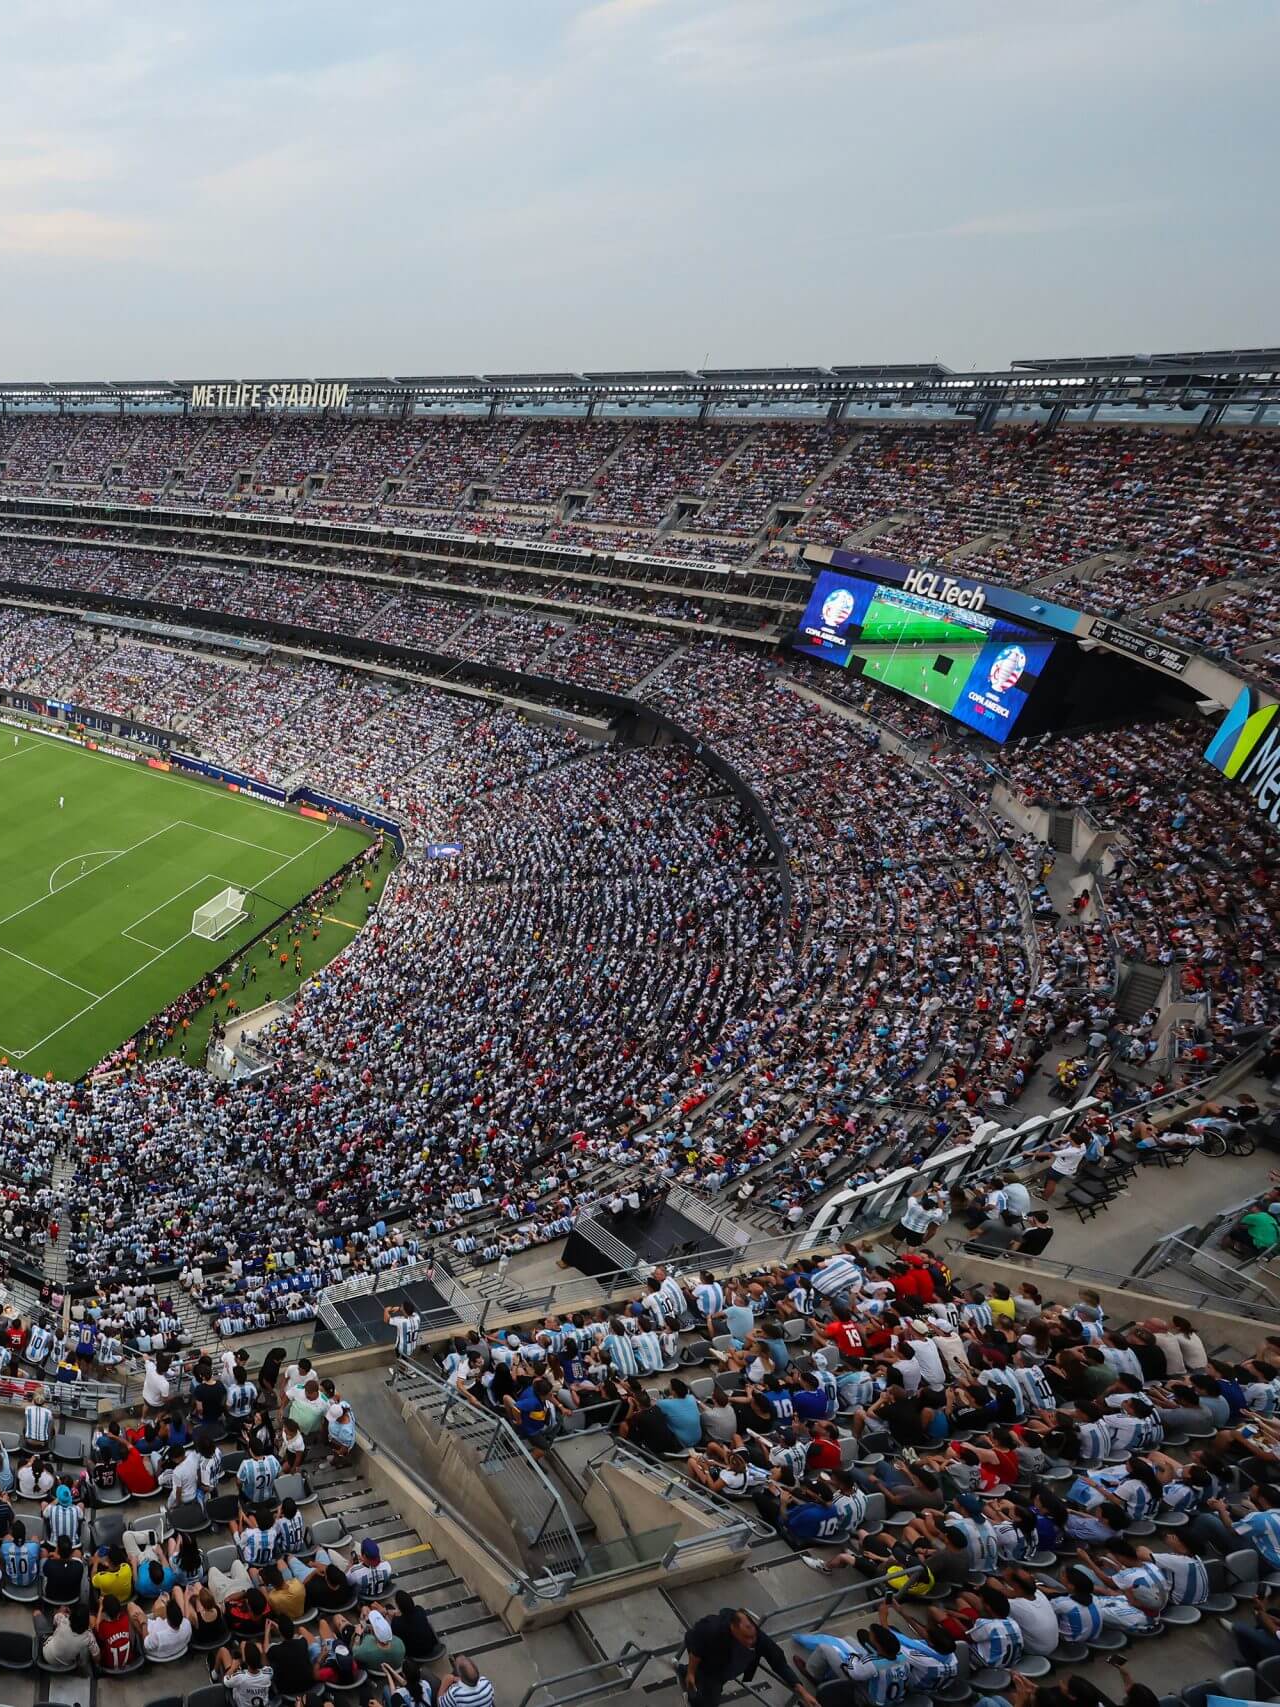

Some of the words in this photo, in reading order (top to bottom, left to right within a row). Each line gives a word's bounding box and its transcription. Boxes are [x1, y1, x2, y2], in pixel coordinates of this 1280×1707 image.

[192, 384, 262, 408] METLIFE
[268, 383, 349, 408] STADIUM
[554, 546, 583, 554] LYONS
[666, 560, 716, 570] MANGOLD
[903, 568, 986, 611] HCLTech
[805, 627, 821, 637] COPA
[821, 632, 846, 647] AMERICA
[1161, 659, 1185, 671] FIRST
[968, 691, 985, 705] COPA
[984, 699, 1010, 719] AMERICA
[97, 744, 136, 761] mastercard
[239, 787, 285, 808] mastercard
[281, 1282, 289, 1290] 10
[303, 1275, 310, 1283] 10
[661, 1297, 674, 1313] 10
[946, 1311, 958, 1327] 10
[31, 1335, 43, 1350] 10
[81, 1328, 91, 1345] 10
[845, 1328, 862, 1347] 19
[774, 1398, 793, 1418] 10
[102, 1476, 114, 1487] 10
[256, 1473, 271, 1490] 21
[816, 1517, 839, 1537] 10
[10, 1557, 28, 1579] 10
[110, 1641, 130, 1670] 17
